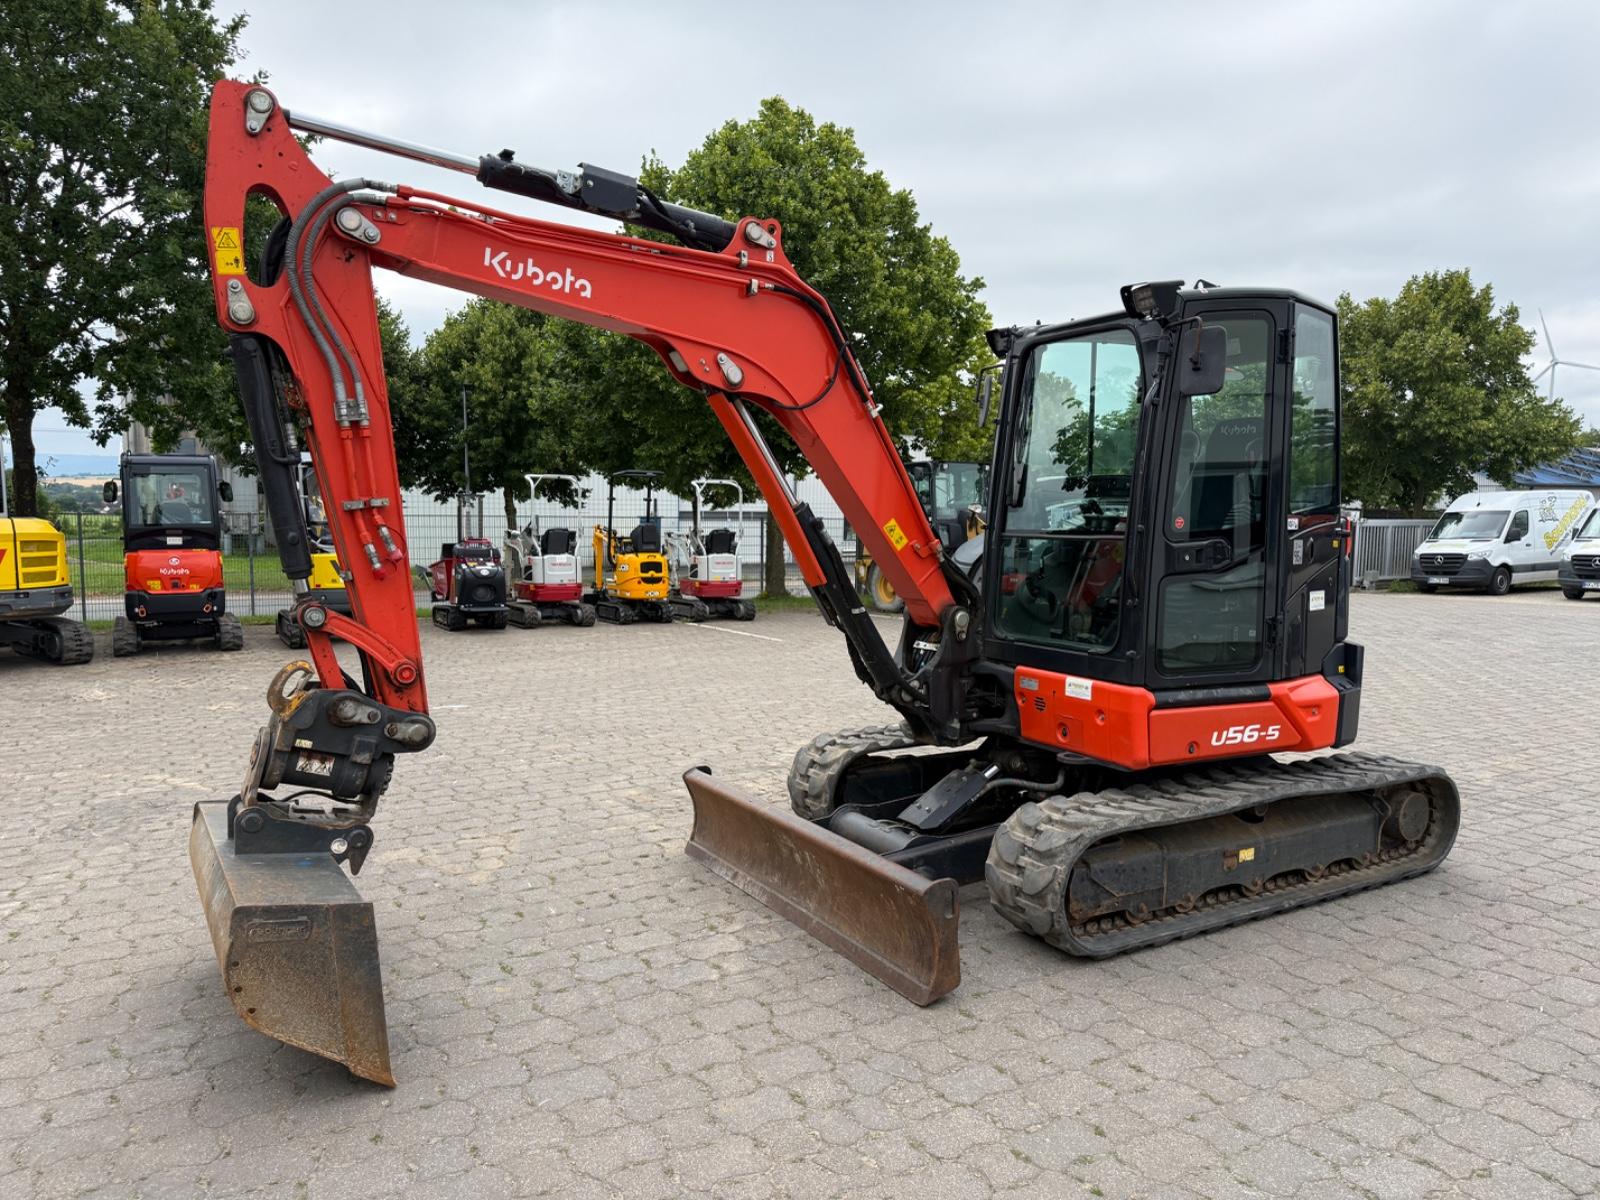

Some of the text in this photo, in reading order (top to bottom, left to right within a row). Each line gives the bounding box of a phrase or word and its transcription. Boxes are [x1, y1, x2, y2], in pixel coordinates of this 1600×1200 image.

[484, 247, 592, 298] Kubota
[1221, 424, 1257, 436] Kubota
[1211, 724, 1281, 746] U56-5
